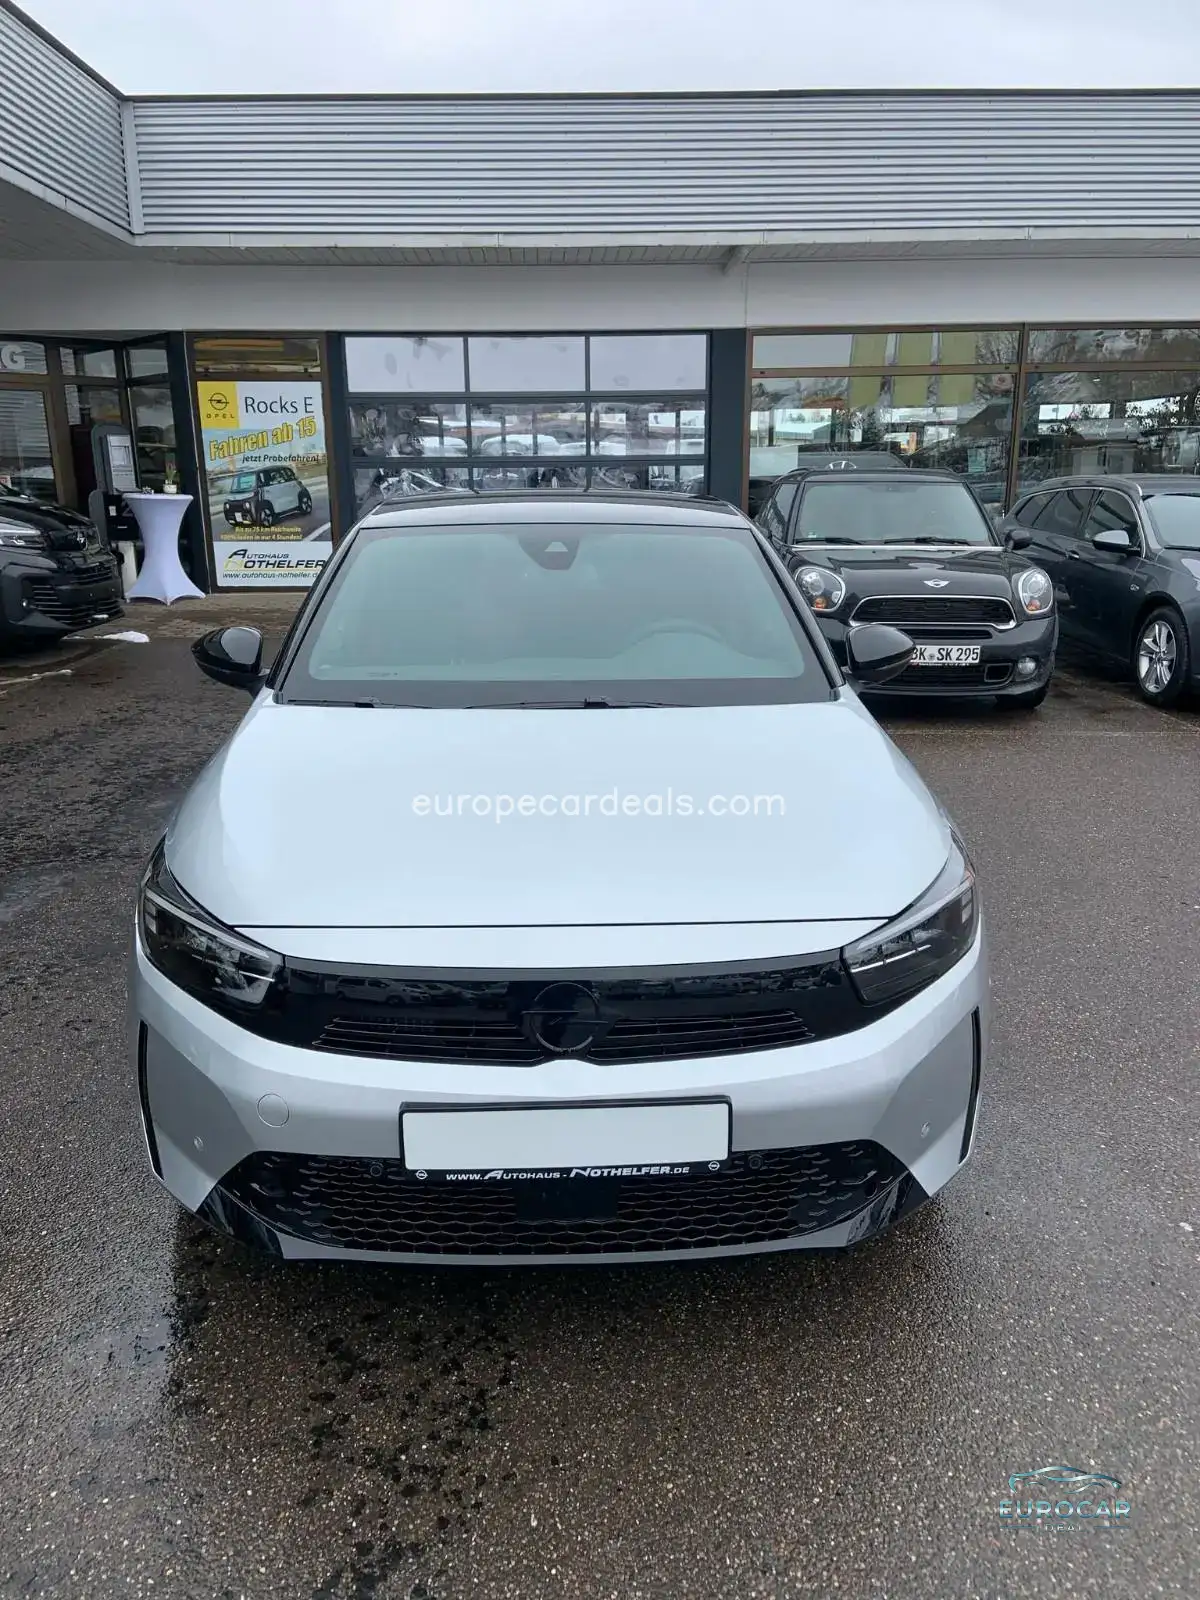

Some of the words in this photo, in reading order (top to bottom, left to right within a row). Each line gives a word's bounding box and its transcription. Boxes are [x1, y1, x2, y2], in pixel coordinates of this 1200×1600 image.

[244, 395, 298, 414] Rocks
[303, 396, 314, 414] E
[209, 431, 269, 461] Fahren
[271, 422, 294, 445] ab
[296, 415, 317, 439] 15
[242, 455, 261, 464] jetzt
[263, 454, 319, 463] Probefahren!
[936, 647, 954, 661] SK
[955, 647, 980, 661] 295
